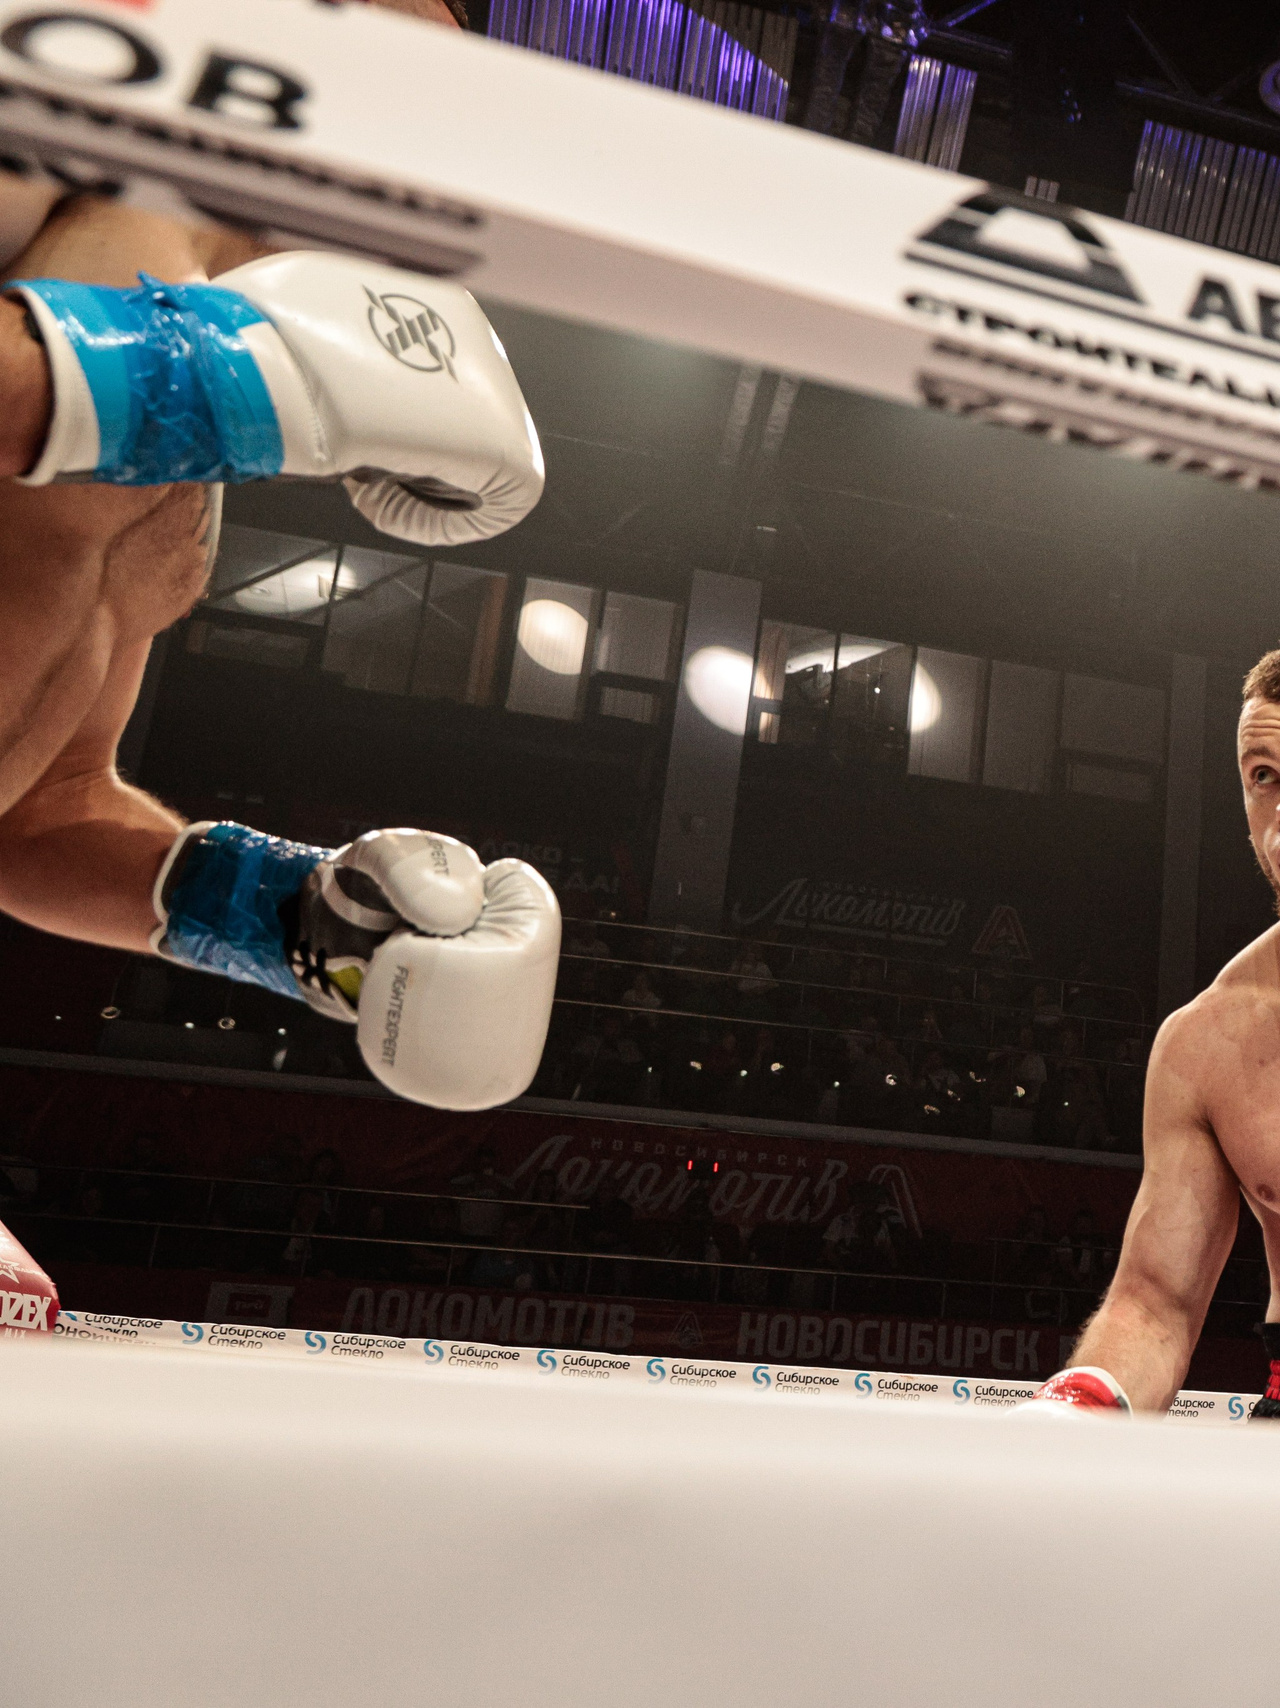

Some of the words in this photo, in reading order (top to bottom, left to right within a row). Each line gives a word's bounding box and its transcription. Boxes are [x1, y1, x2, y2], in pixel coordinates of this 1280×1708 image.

[381, 965, 409, 1067] FIGHTEXPERT
[210, 1324, 287, 1341] Сибирское
[208, 1335, 263, 1350] Стекло
[333, 1334, 406, 1349] Сибирское
[736, 1311, 1040, 1372] НОВОСИБИРСК
[331, 1345, 384, 1360] Стекло
[450, 1344, 520, 1360] Сибирское
[448, 1355, 499, 1370] Стекло
[562, 1354, 631, 1370] Сибирское
[561, 1365, 610, 1380] Стекло
[671, 1364, 737, 1379] Сибирское
[776, 1371, 840, 1386] Сибирское
[669, 1375, 717, 1388] Стекло
[775, 1382, 821, 1396] Стекло
[877, 1378, 939, 1393] Сибирское
[876, 1389, 920, 1402] Стекло
[975, 1385, 1034, 1399] Сибирское
[973, 1395, 1016, 1408] Стекло
[1172, 1397, 1215, 1409] бирское
[1168, 1409, 1199, 1418] текло
